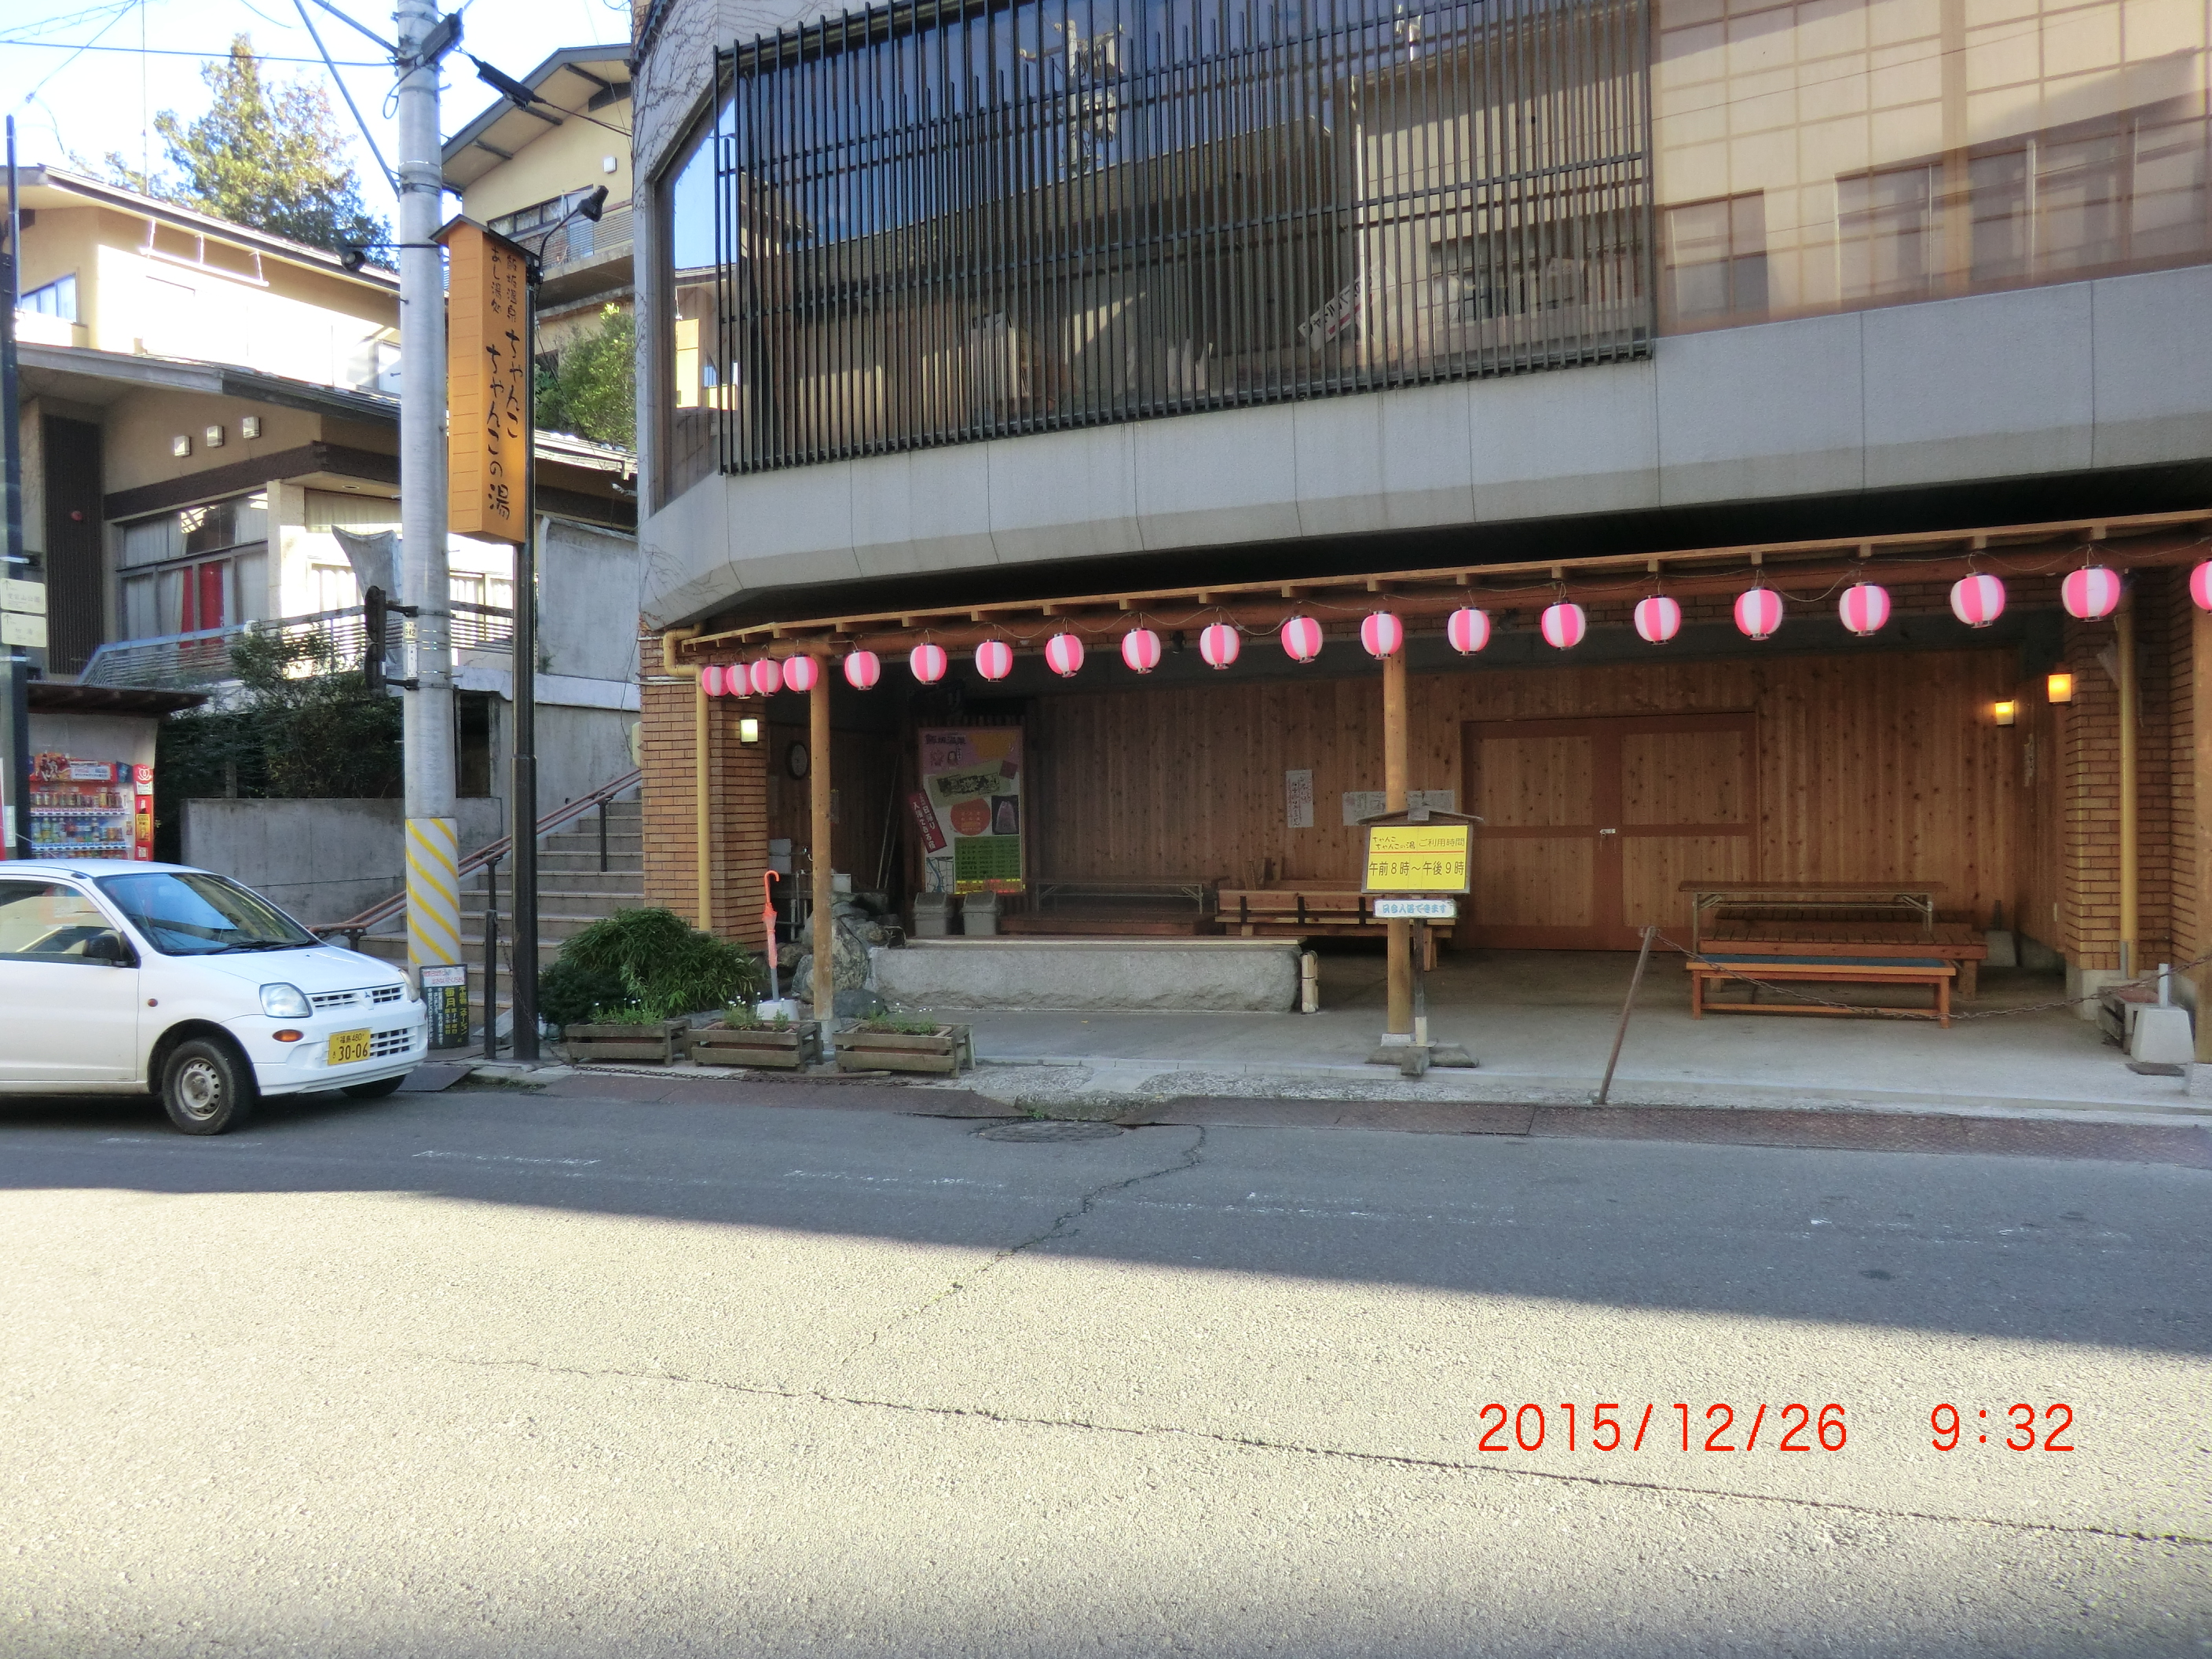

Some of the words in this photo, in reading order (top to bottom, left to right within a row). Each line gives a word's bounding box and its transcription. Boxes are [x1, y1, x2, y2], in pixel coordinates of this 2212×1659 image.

[507, 255, 518, 323] 飯坂温泉
[485, 343, 511, 521] ちゃんこの湯
[1375, 840, 1415, 850] ちゃんこの湯
[1419, 837, 1465, 848] ご利用時間
[1382, 903, 1447, 914] 只今入浴できます
[338, 1042, 368, 1061] 30-06
